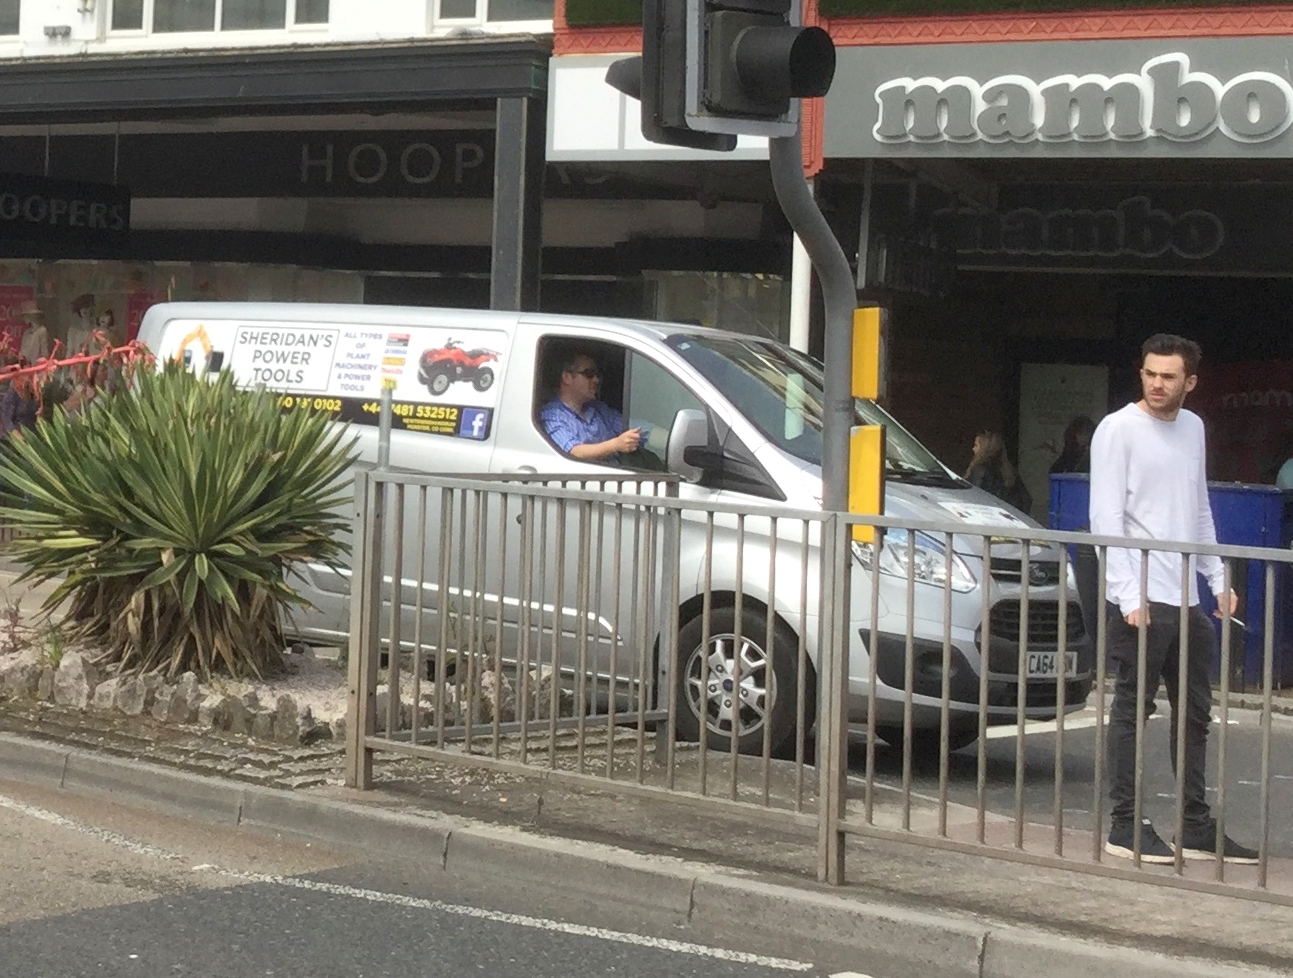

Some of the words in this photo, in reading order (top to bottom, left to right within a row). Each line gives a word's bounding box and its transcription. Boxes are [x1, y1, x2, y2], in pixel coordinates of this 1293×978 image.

[872, 52, 1293, 143] mambo
[238, 331, 334, 348] SHERIDAN'S
[344, 331, 357, 339] ALL
[360, 332, 383, 340] TYPES
[252, 349, 311, 365] POWER
[346, 352, 371, 360] PLANT
[334, 362, 378, 371] MACHINERY
[253, 367, 304, 384] TOOLS
[343, 373, 372, 381] POWER
[340, 383, 365, 391] TOOLS
[314, 398, 342, 411] 0102
[416, 405, 458, 420] 532512
[1028, 654, 1055, 675] CA64
